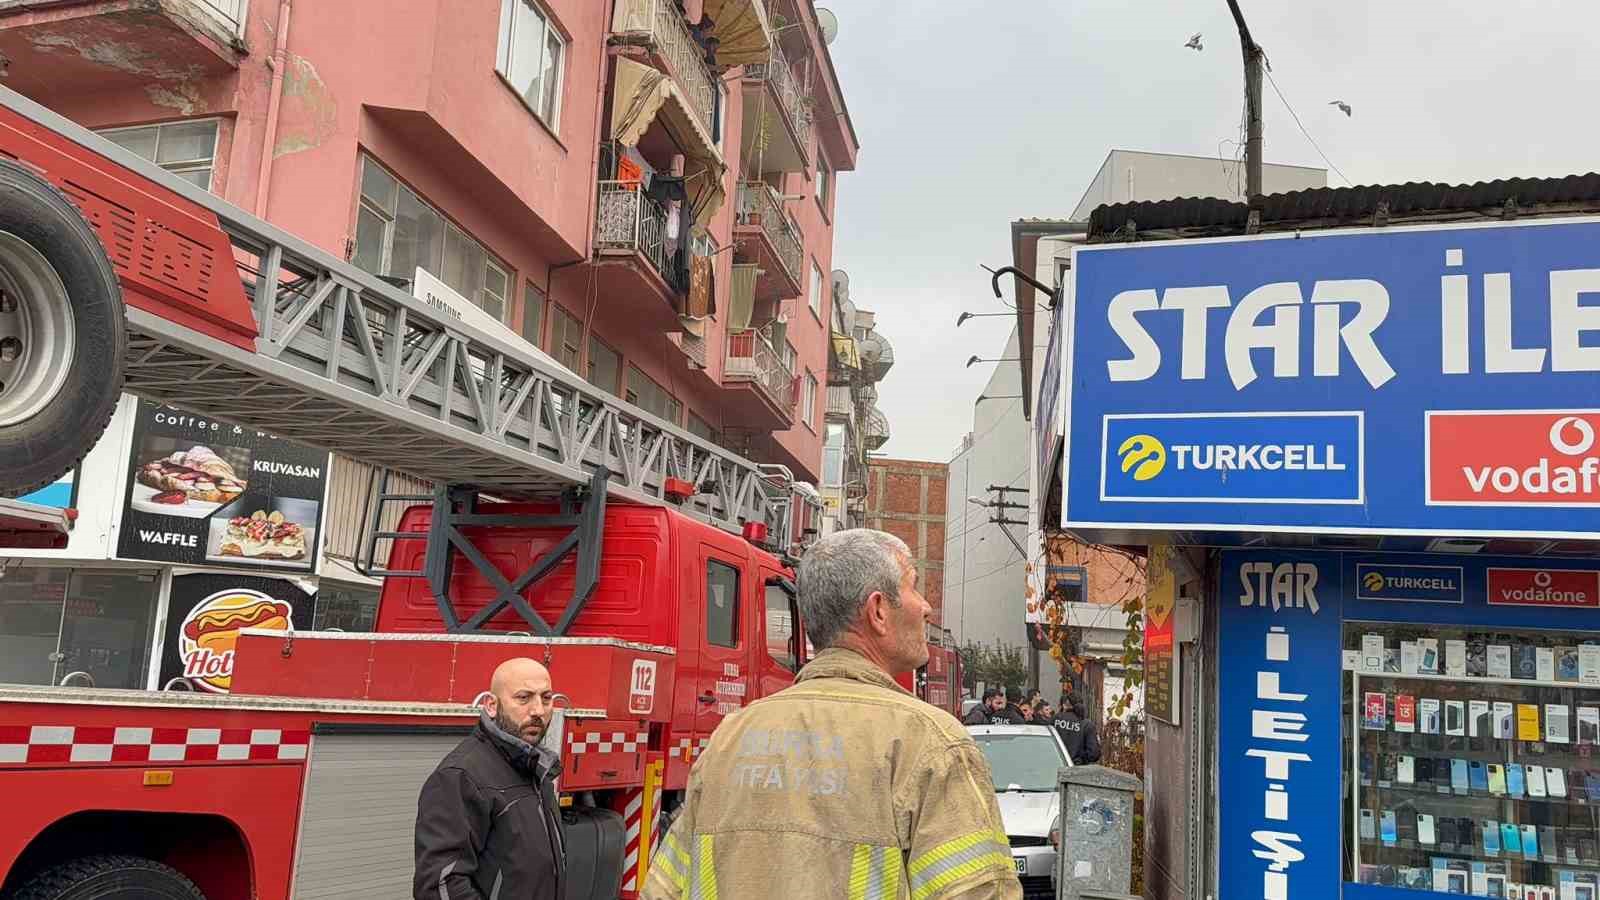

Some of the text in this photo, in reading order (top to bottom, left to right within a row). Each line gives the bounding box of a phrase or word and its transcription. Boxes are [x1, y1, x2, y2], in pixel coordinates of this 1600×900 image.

[1107, 248, 1600, 391] STAR İLE
[155, 412, 242, 434] Coffee &
[253, 460, 320, 479] KRUVASAN
[1171, 444, 1346, 471] TURKCELL
[1463, 456, 1600, 494] vodaf
[139, 529, 198, 548] WAFFLE
[1240, 562, 1320, 615] STAR
[1385, 576, 1457, 590] TURKCELL
[1501, 588, 1586, 603] vodafone
[185, 650, 234, 677] Hot
[635, 666, 652, 691] 112
